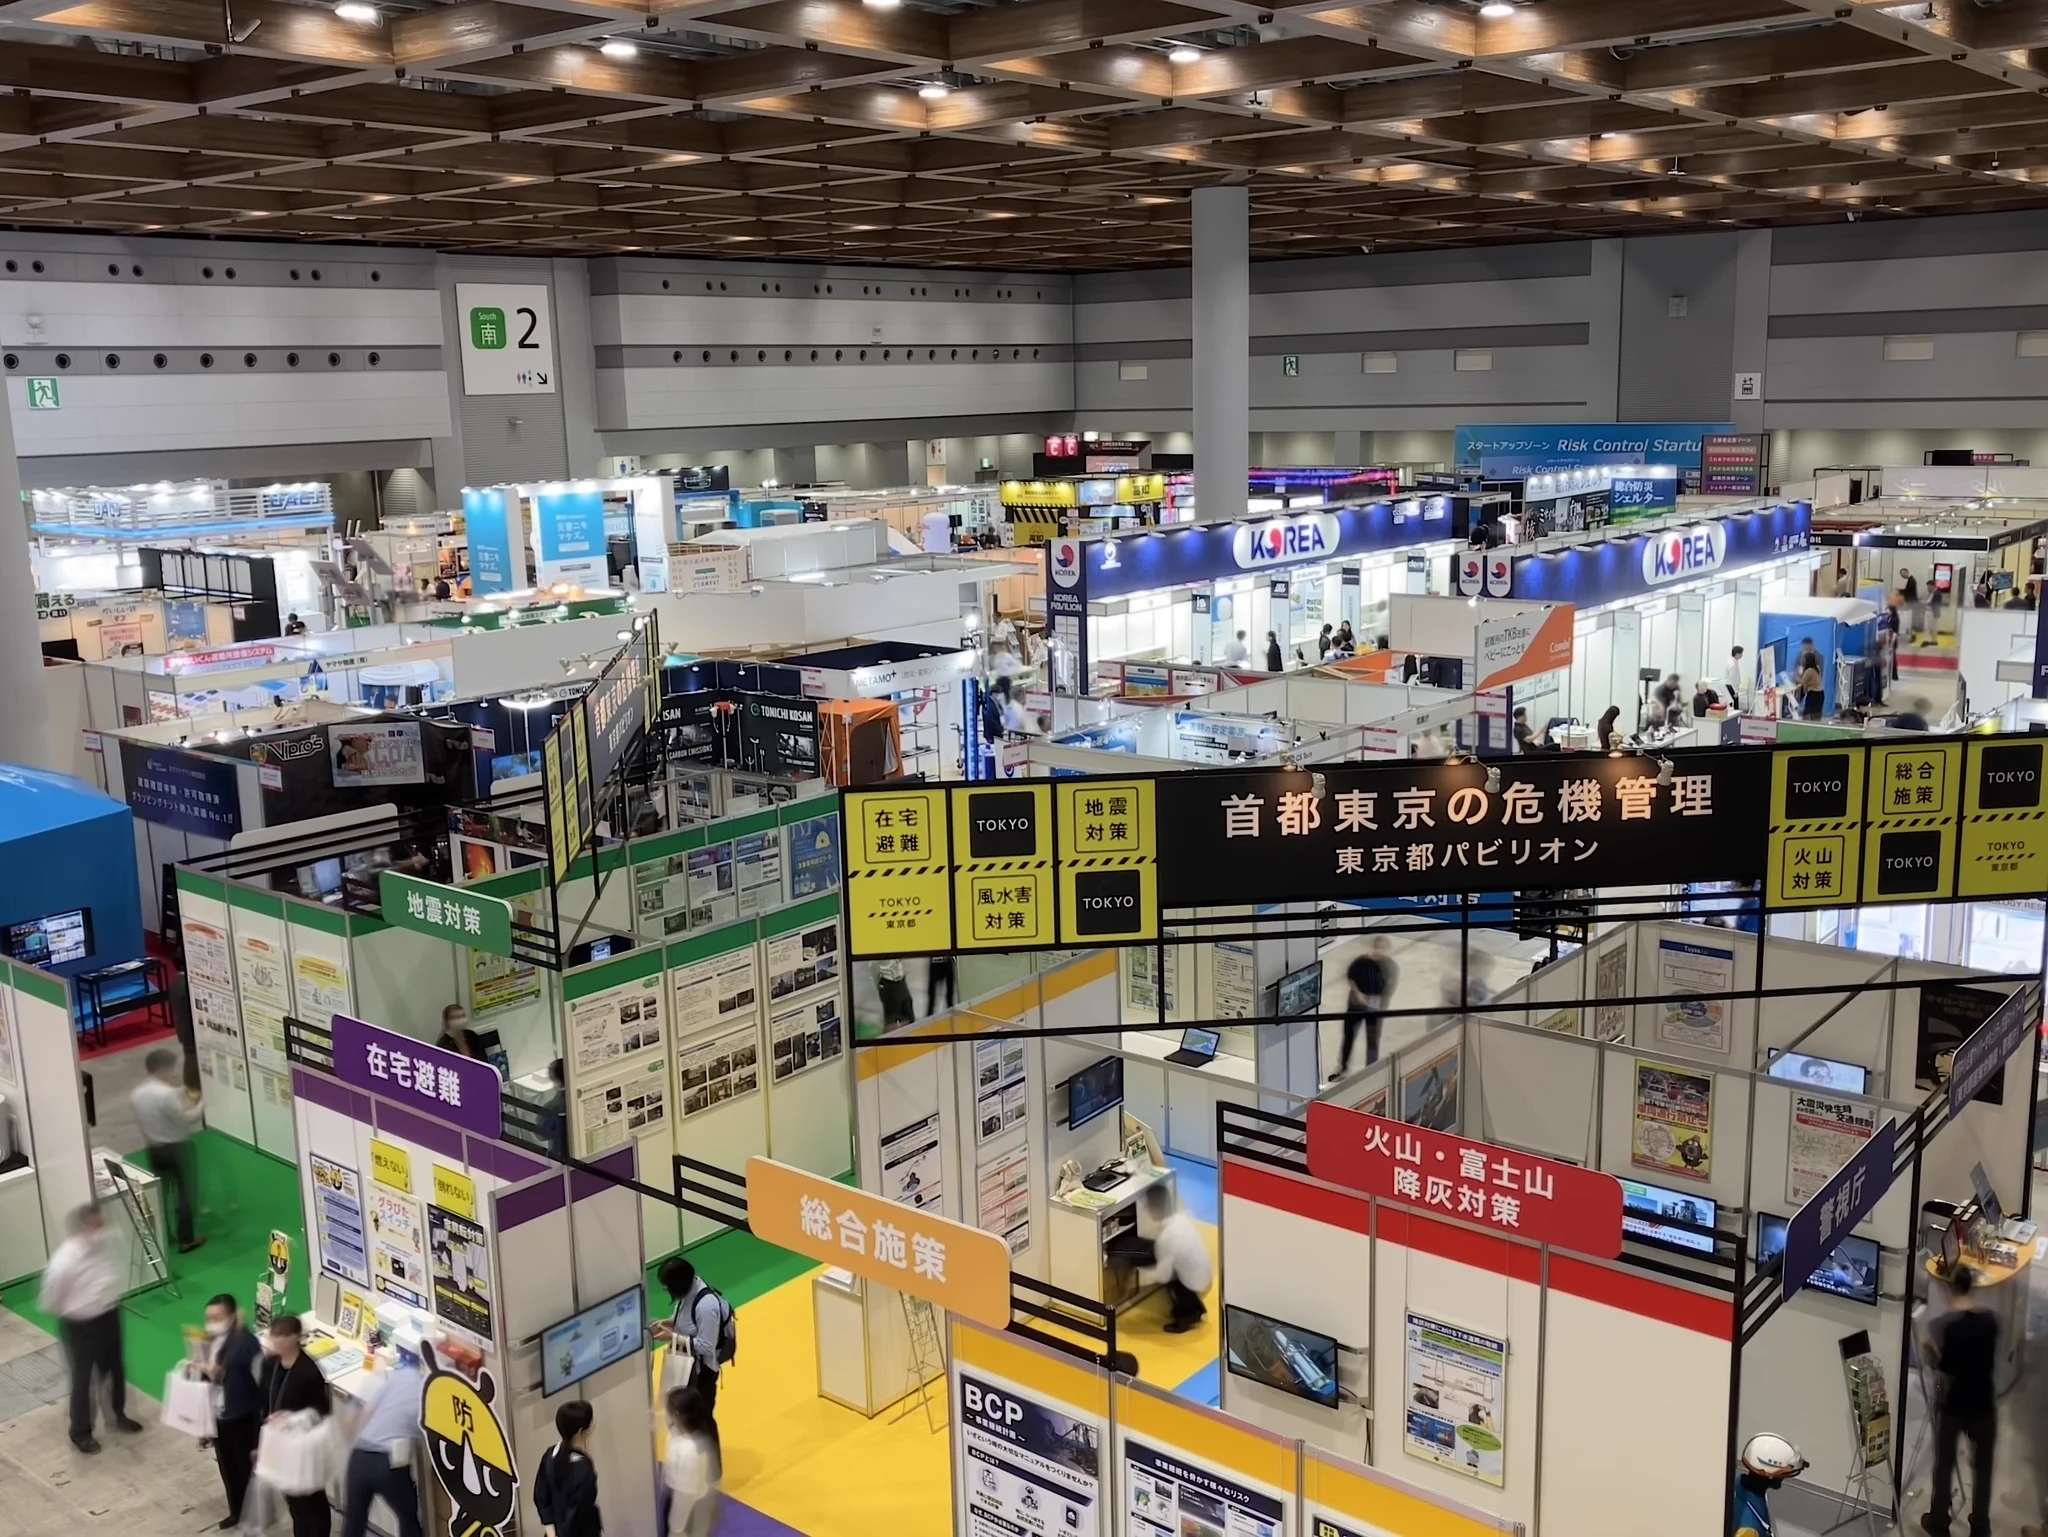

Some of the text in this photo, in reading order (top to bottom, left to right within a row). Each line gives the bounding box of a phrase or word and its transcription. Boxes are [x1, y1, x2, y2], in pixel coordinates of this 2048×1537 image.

[478, 312, 497, 320] South
[480, 322, 497, 345] 南
[516, 307, 539, 349] 2
[1557, 439, 1588, 452] Risk
[1593, 439, 1649, 453] Control
[1652, 439, 1702, 453] Startu
[1614, 480, 1653, 493] 総合防災
[1614, 492, 1665, 504] シェルター
[1250, 522, 1325, 560] KOREA
[1653, 531, 1715, 579] KOREA
[1055, 569, 1077, 577] KOREA
[1050, 600, 1083, 613] PAVILION
[1053, 593, 1078, 602] KOREA
[761, 705, 813, 723] TONICHI KOSAN
[267, 733, 324, 762] Vipro's
[1895, 761, 1935, 781] 総合
[1987, 770, 2036, 784] TOKYO
[1793, 780, 1842, 794] TOKYO
[1893, 786, 1934, 806] 施策
[1085, 797, 1128, 817] 地震
[1221, 774, 1714, 839] 首都東京の危機管理
[874, 808, 918, 829] 在宅
[976, 818, 1029, 832] TOKYO
[1085, 822, 1129, 842] 対策
[875, 834, 919, 854] 避難
[1987, 841, 2025, 852] TOKYO
[1335, 838, 1600, 875] 東京都パビリオン
[1794, 847, 1833, 866] 火山
[1885, 856, 1933, 869] TOKYO
[1991, 862, 2019, 872] 東京都
[1792, 871, 1832, 890] 対策
[879, 896, 922, 908] TOKYO
[976, 886, 1033, 906] 風水害
[1082, 896, 1134, 910] TOKYO
[2024, 901, 2047, 911] RESE
[407, 890, 481, 935] 地震対策
[984, 911, 1026, 930] 対策
[886, 919, 917, 929] 東京都
[366, 1042, 462, 1108] 在宅避難
[1363, 1125, 1553, 1200] 火山・富士山
[1393, 1166, 1521, 1228] 降灰対策
[1819, 1164, 1867, 1245] 警視庁
[800, 1193, 948, 1284] 総合施策
[452, 1394, 474, 1433] 防
[964, 1382, 1024, 1426] BCP
